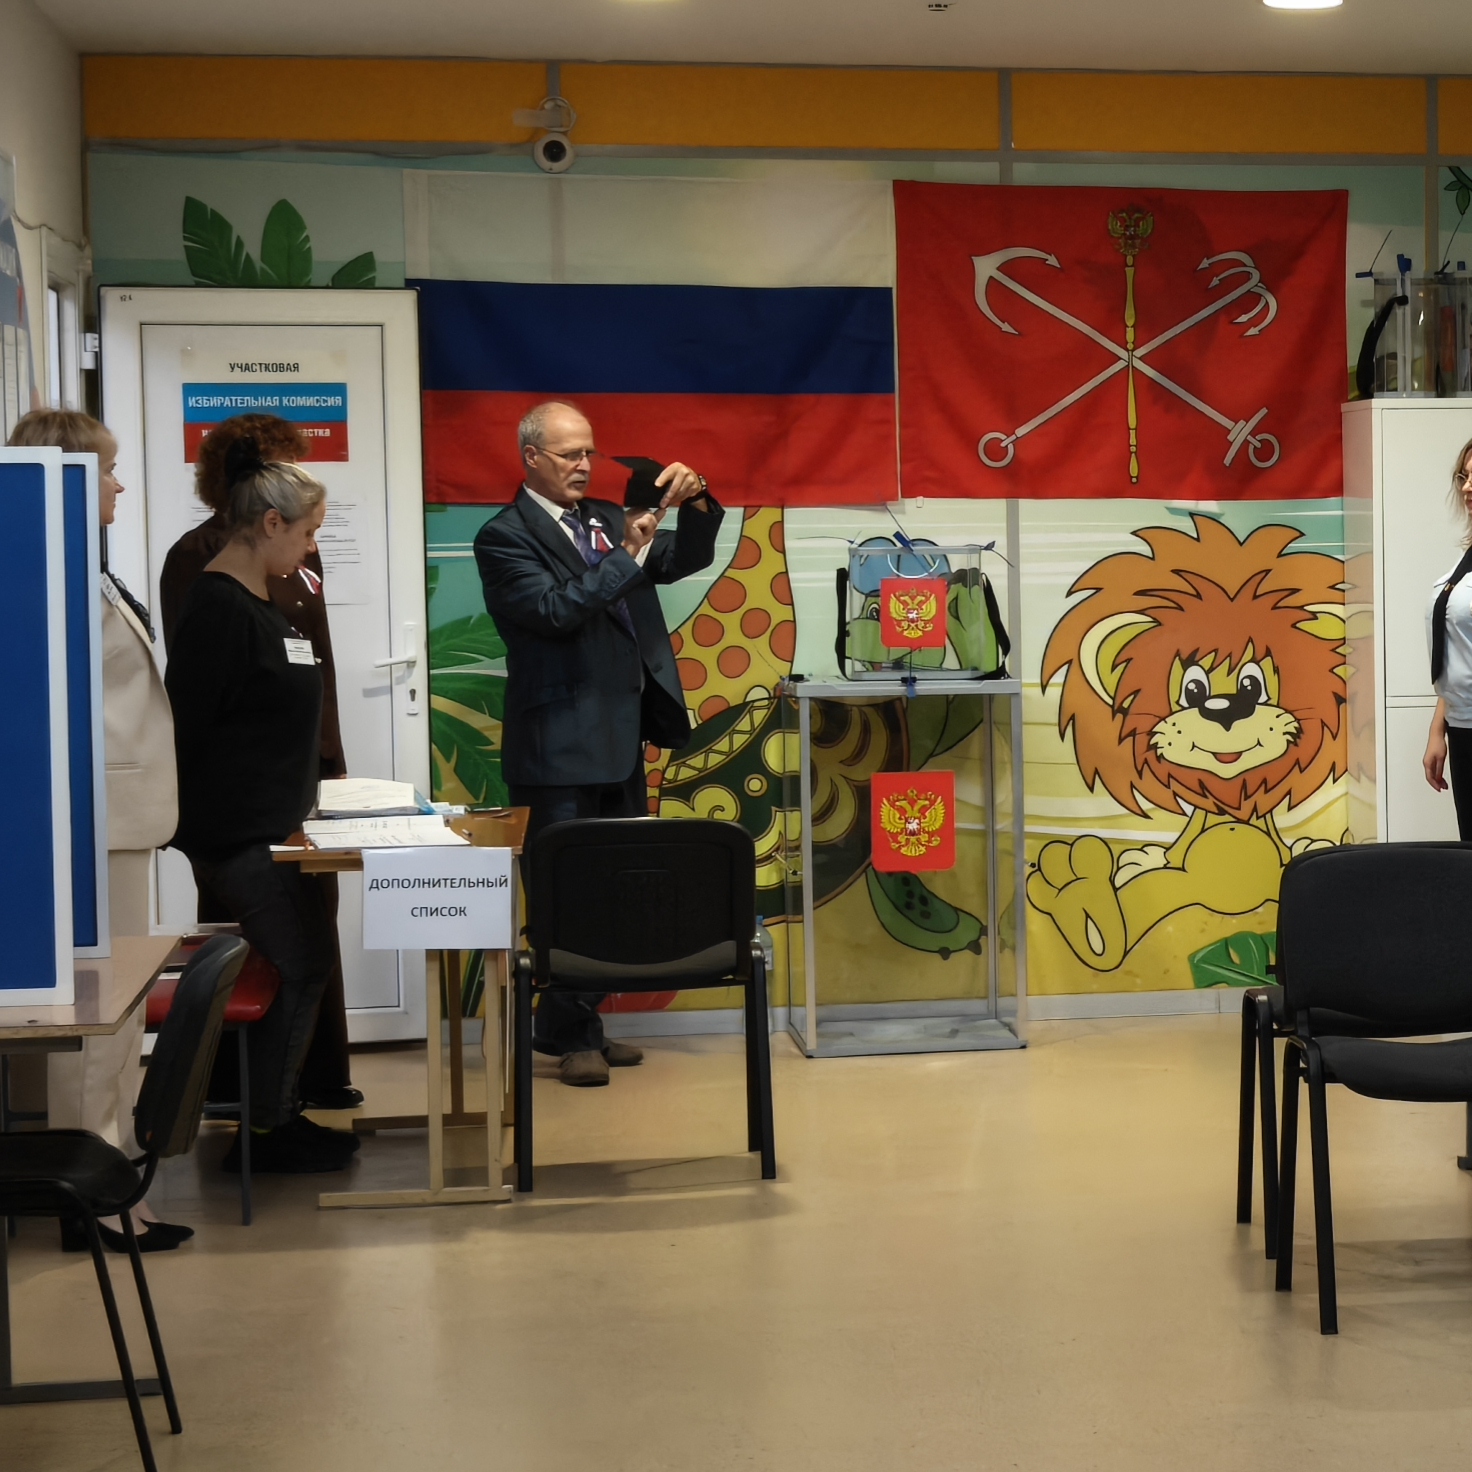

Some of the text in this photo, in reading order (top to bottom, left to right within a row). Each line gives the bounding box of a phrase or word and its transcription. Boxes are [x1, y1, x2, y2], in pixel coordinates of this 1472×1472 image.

[228, 362, 300, 374] УЧАСТКОВАЯ
[188, 395, 343, 408] ИЗБИРАТЕЛЬНАЯ КОМИССИЯ
[368, 875, 509, 892] ДОПОЛНИТЕЛЬНЫЙ
[411, 906, 468, 918] СПИСОК
